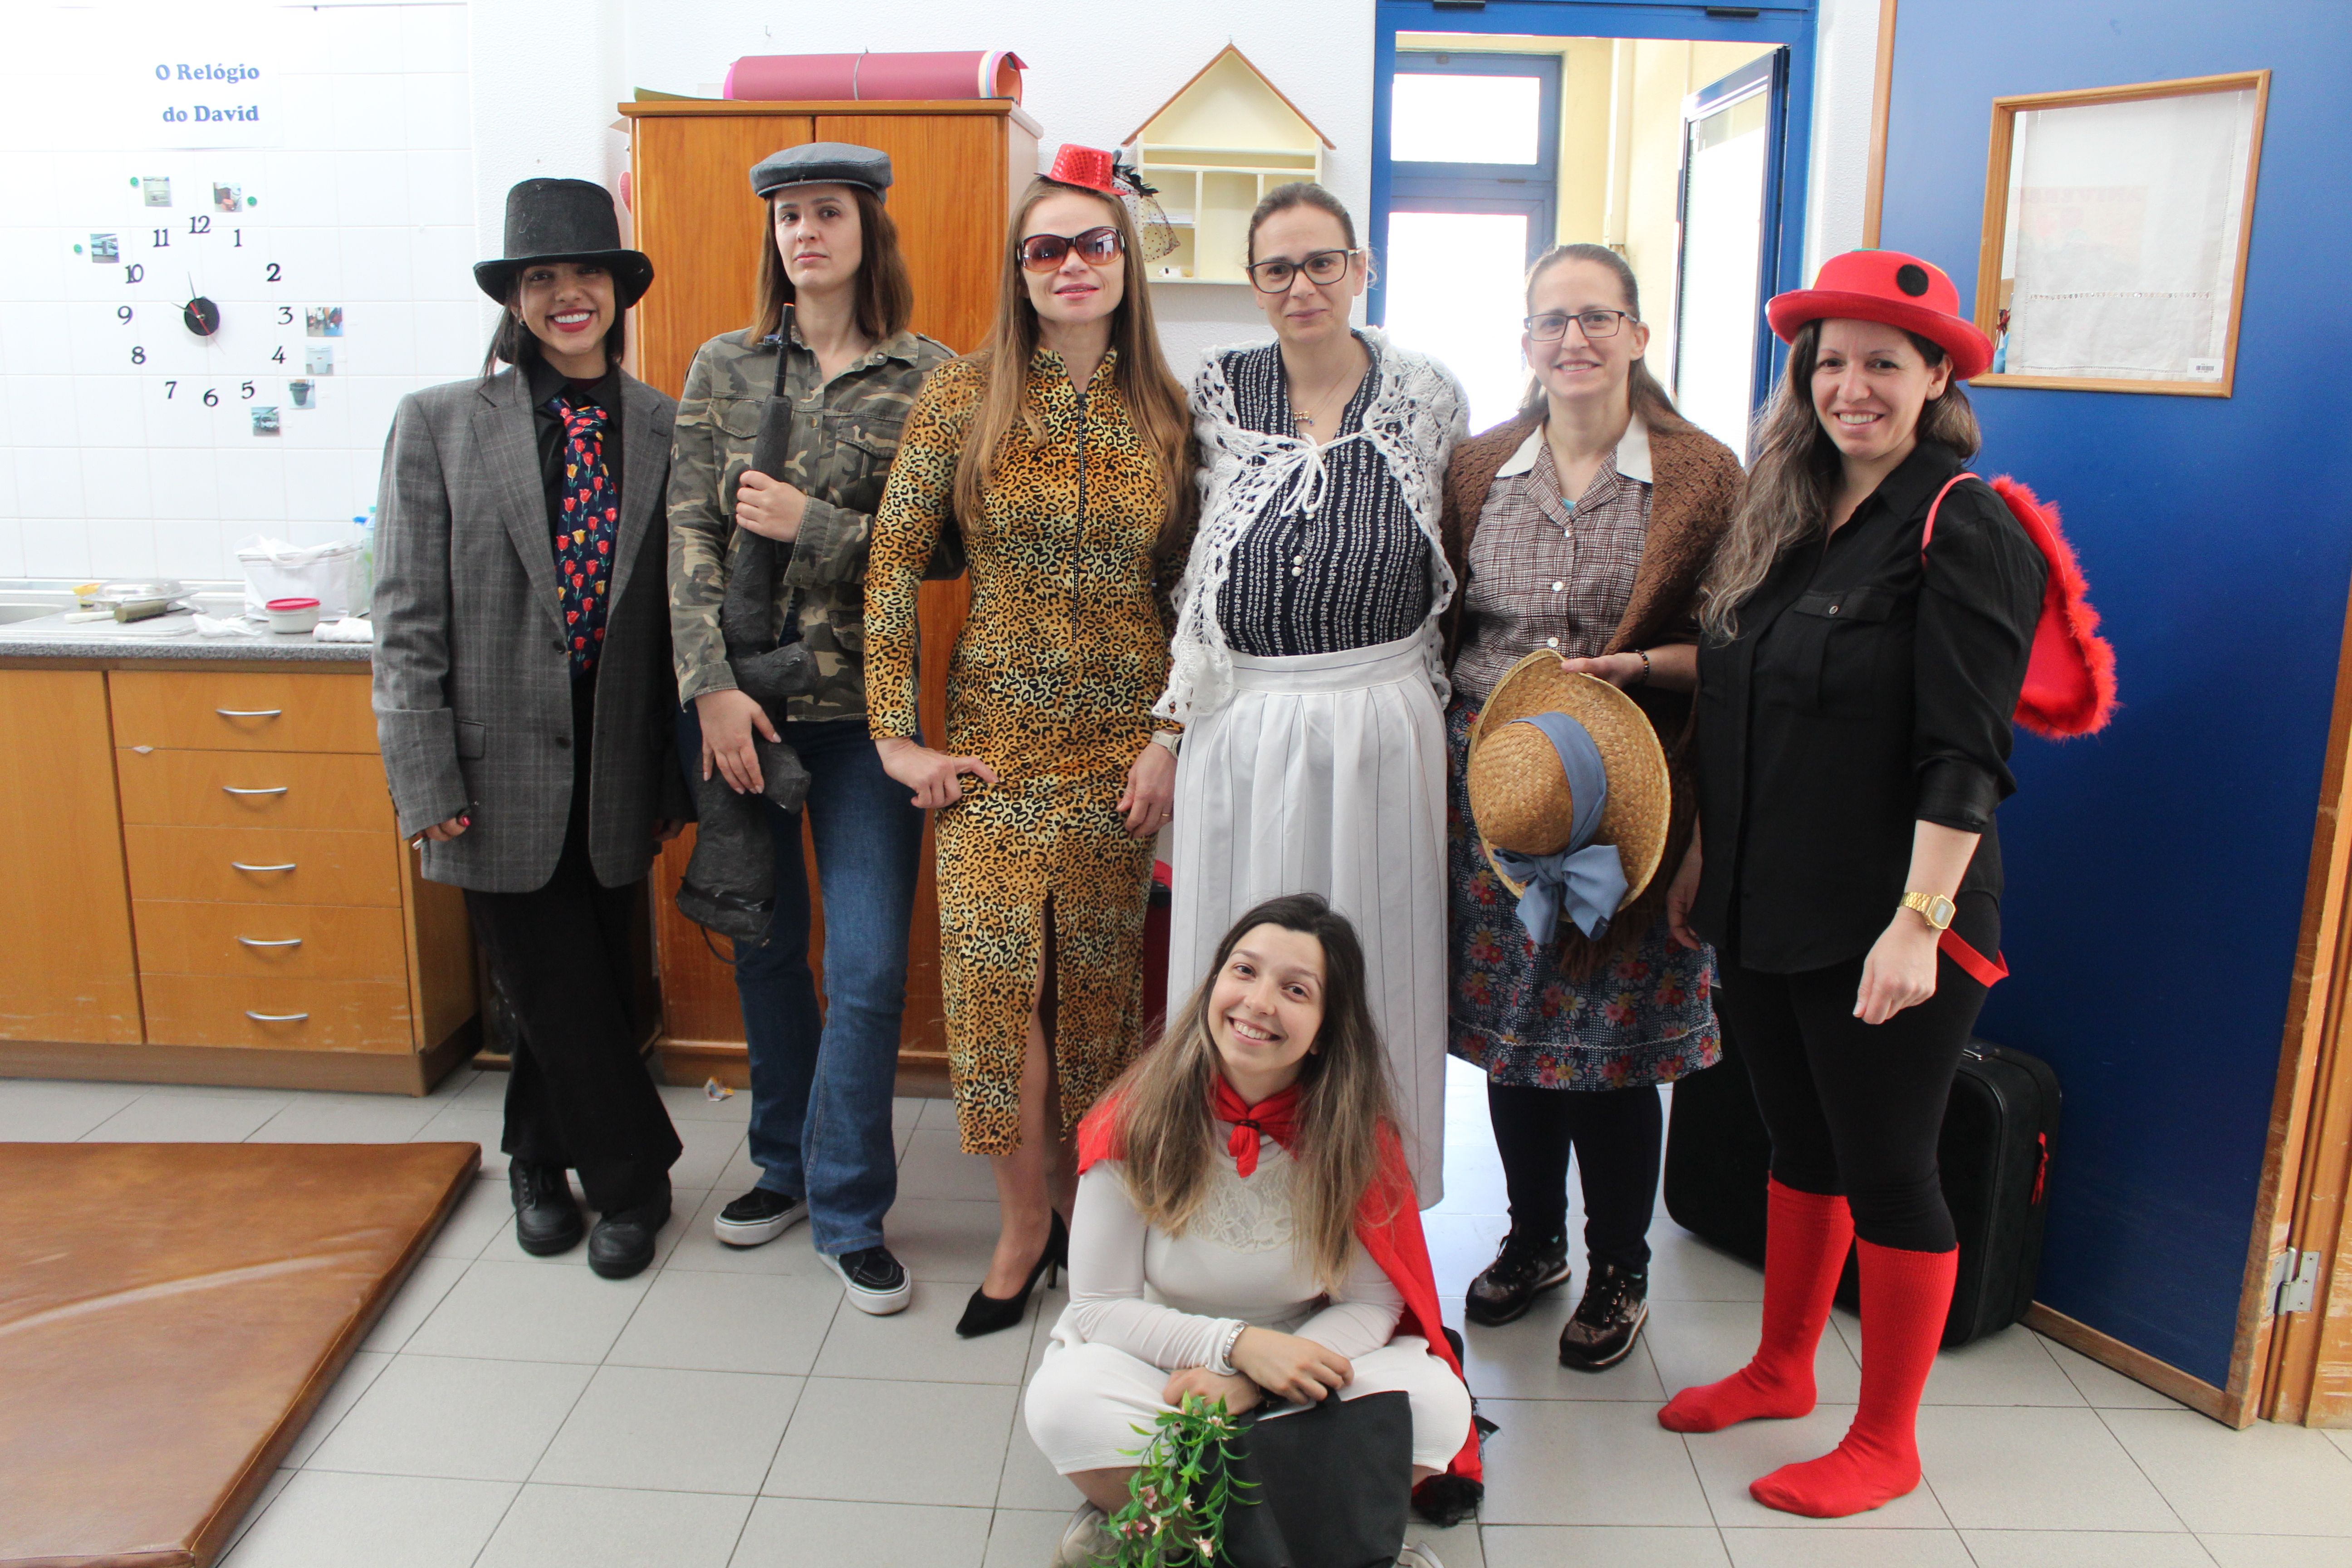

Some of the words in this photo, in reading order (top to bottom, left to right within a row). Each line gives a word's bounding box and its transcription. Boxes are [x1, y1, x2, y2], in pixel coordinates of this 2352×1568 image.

[156, 64, 171, 81] O
[176, 63, 260, 84] Relógio
[162, 107, 188, 122] do
[193, 105, 260, 122] David
[189, 216, 211, 234] 12
[153, 229, 170, 247] 11
[234, 229, 242, 247] 1
[125, 264, 144, 284] 10
[266, 263, 281, 282] 2
[118, 306, 133, 325] 9
[278, 306, 294, 325] 3
[131, 346, 147, 365] 8
[271, 346, 286, 364] 4
[165, 381, 177, 399] 7
[203, 388, 219, 407] 6
[241, 381, 255, 399] 5
